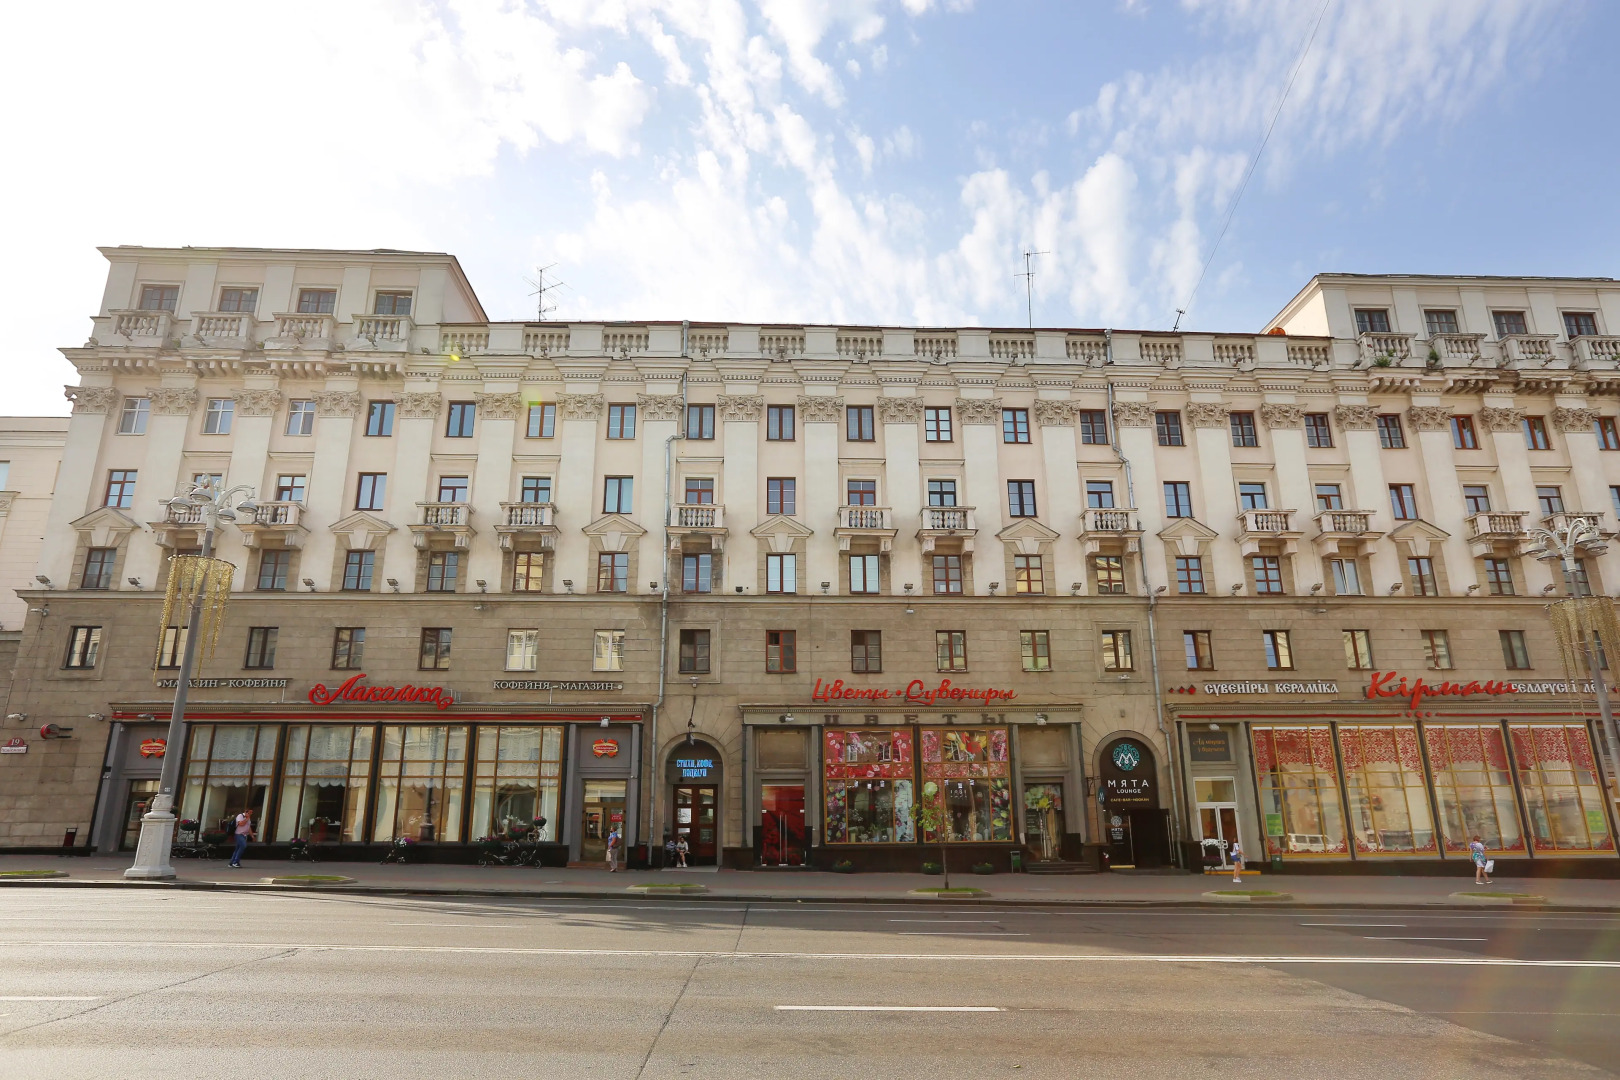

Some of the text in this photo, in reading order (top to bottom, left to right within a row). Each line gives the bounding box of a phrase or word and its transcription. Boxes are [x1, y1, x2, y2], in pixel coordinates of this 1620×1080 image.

[162, 679, 218, 688] МААЗИН
[228, 678, 287, 688] КОФЕЙНЯ
[493, 680, 550, 690] КОФЕЙНЯ
[560, 682, 614, 691] МАГАЗИН
[308, 673, 454, 710] Лакомка
[812, 678, 1018, 705] Цветы Сувениры
[1366, 671, 1518, 710] Кірмаш
[11, 738, 20, 746] 19
[1107, 779, 1149, 788] МЯТА
